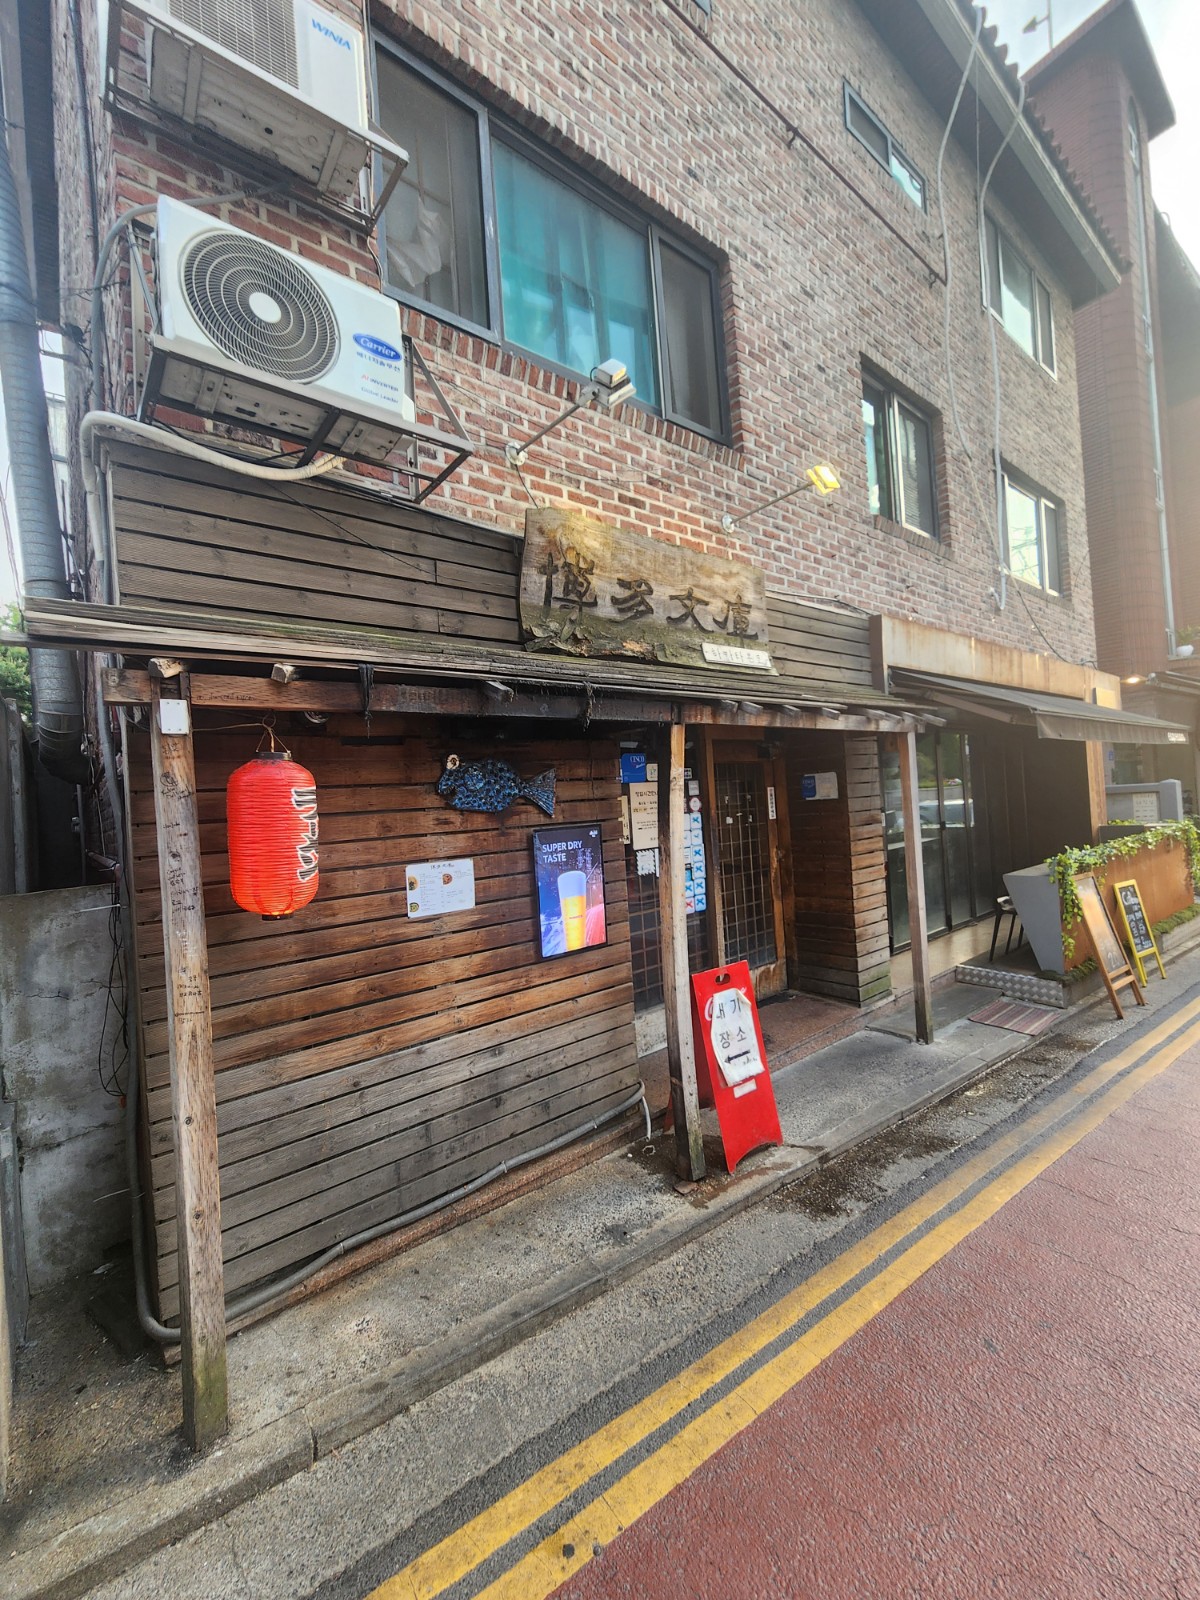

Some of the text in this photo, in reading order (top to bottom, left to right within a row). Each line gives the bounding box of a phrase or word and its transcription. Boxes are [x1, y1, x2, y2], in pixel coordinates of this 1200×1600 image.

[311, 18, 351, 50] WINIA
[360, 337, 397, 358] Carrier
[542, 840, 583, 853] SUPER DRY
[543, 852, 567, 863] TASTE
[719, 1026, 747, 1049] 장소
